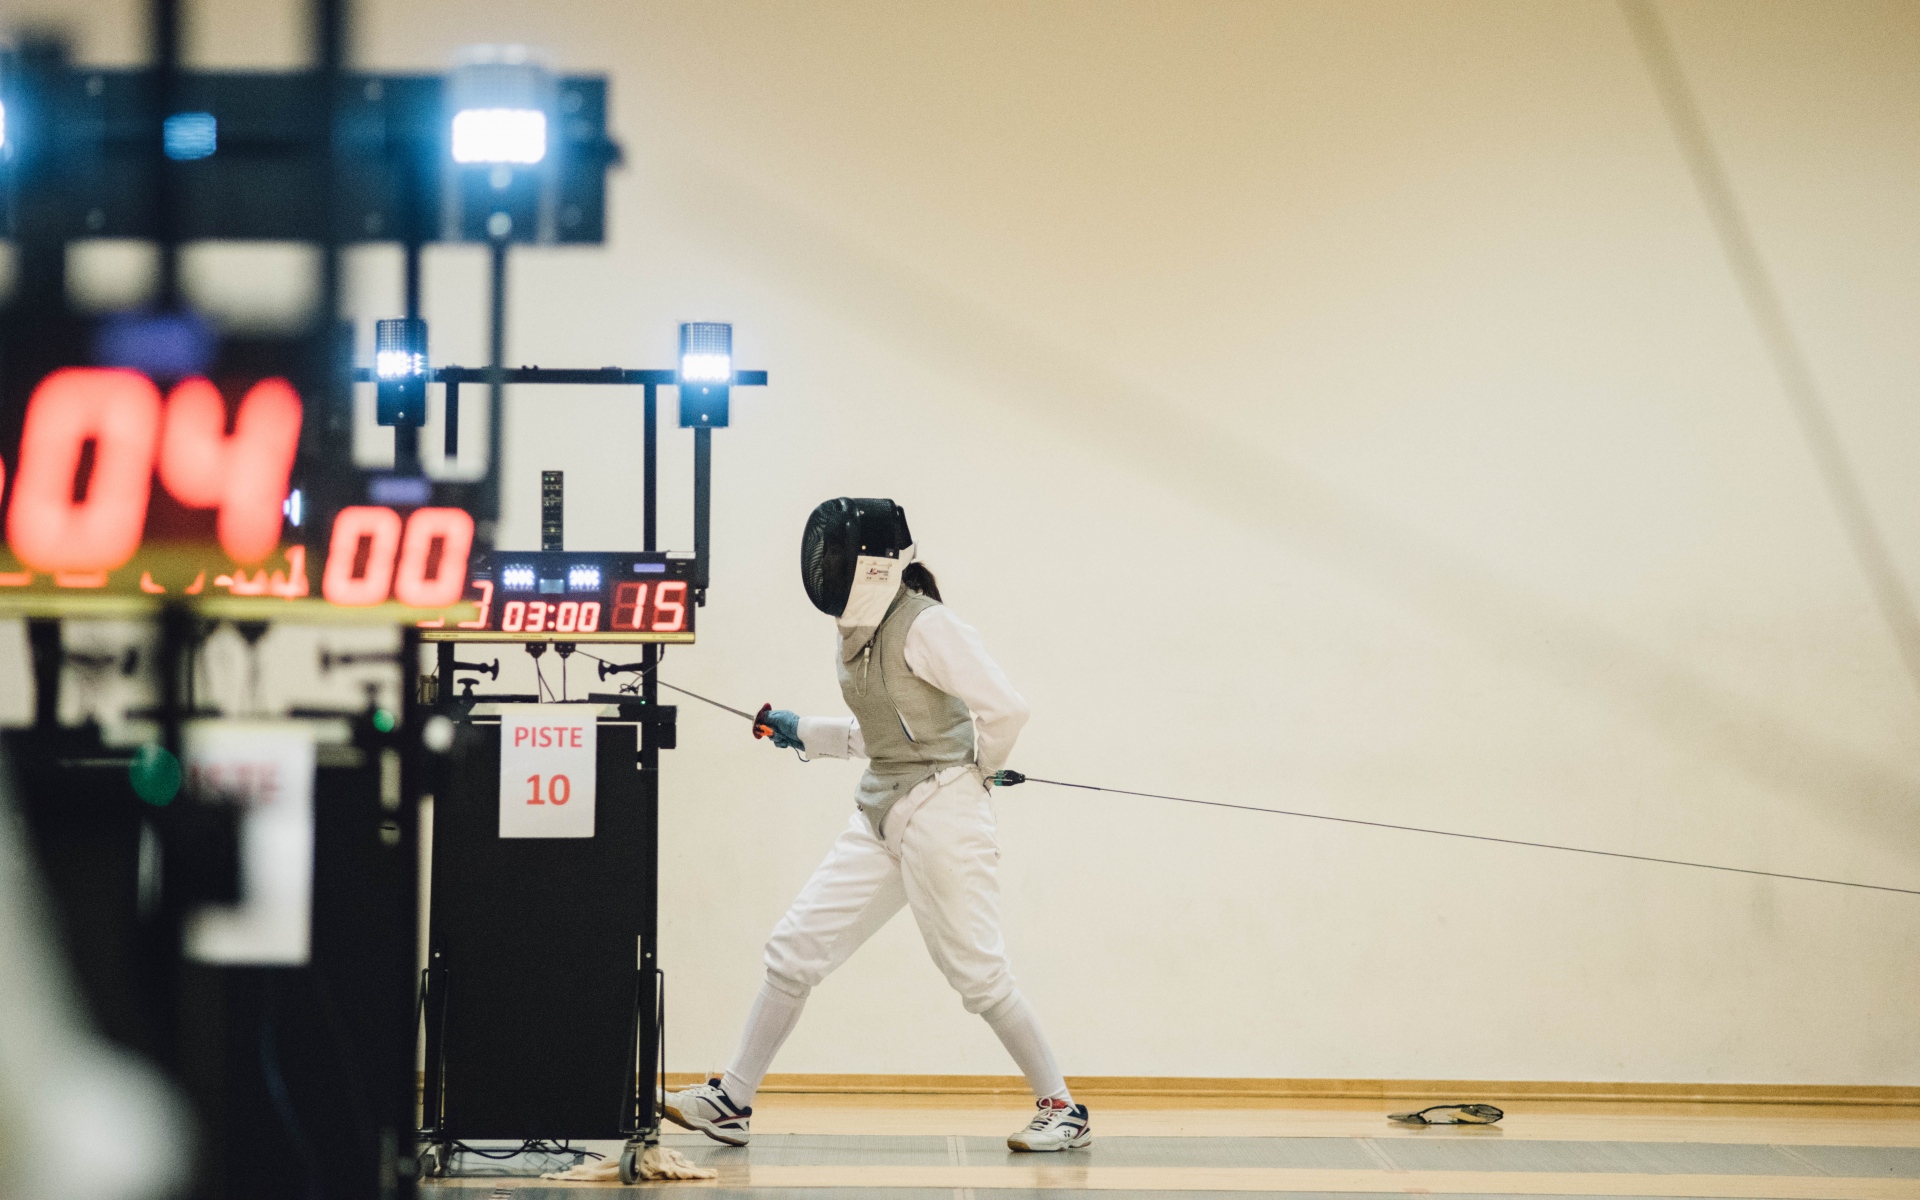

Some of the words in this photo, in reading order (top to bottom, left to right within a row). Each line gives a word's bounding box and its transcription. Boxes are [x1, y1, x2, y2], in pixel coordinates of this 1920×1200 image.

[7, 367, 303, 572] 04
[323, 506, 474, 607] 00
[502, 601, 601, 632] 03:00
[630, 581, 688, 632] 15
[514, 726, 583, 748] PISTE
[526, 774, 571, 806] 10
